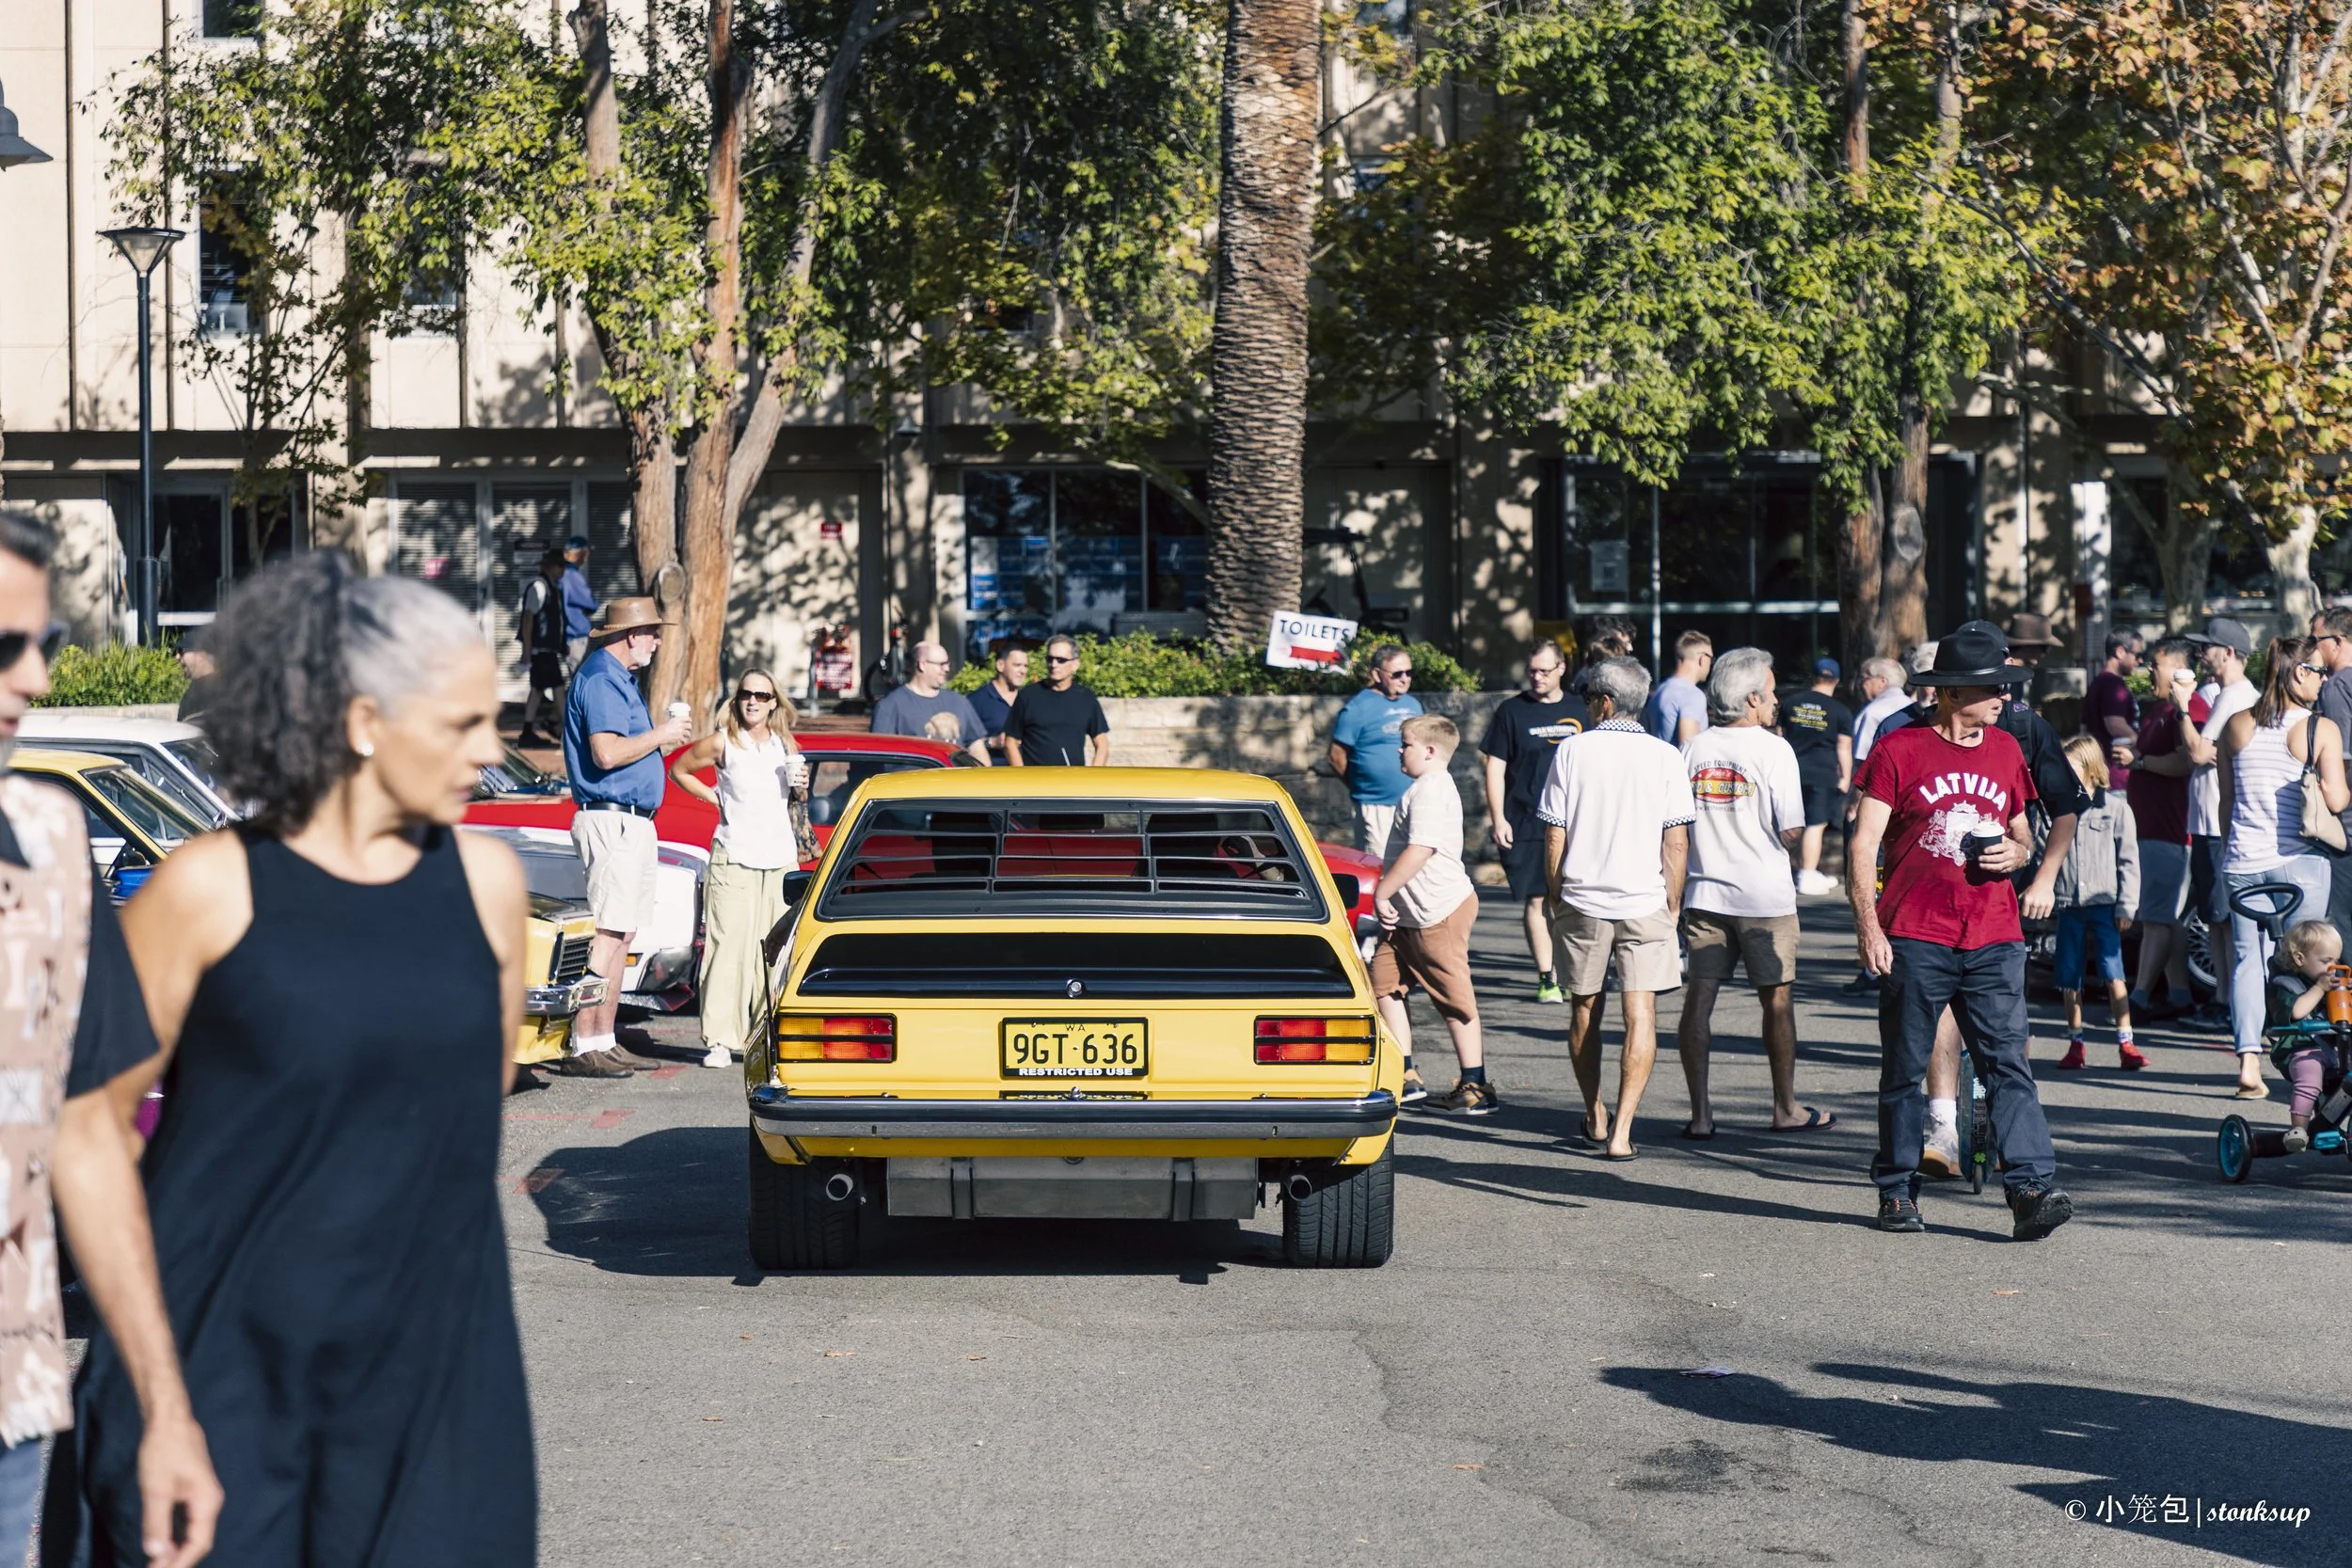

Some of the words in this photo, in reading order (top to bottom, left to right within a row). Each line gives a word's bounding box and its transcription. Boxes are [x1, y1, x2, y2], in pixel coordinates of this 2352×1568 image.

[1279, 619, 1350, 641] TOILETS
[1693, 760, 1711, 772] SPEED
[1713, 759, 1747, 774] EQUIPMENT
[1705, 782, 1713, 793] &
[1718, 782, 1753, 795] CUSTOM
[1918, 771, 2008, 813] LATVIJA
[1013, 1033, 1069, 1065] 9GT
[1083, 1033, 1137, 1065] 636
[1018, 1068, 1103, 1076] RESTRICTED
[1105, 1068, 1134, 1076] USE
